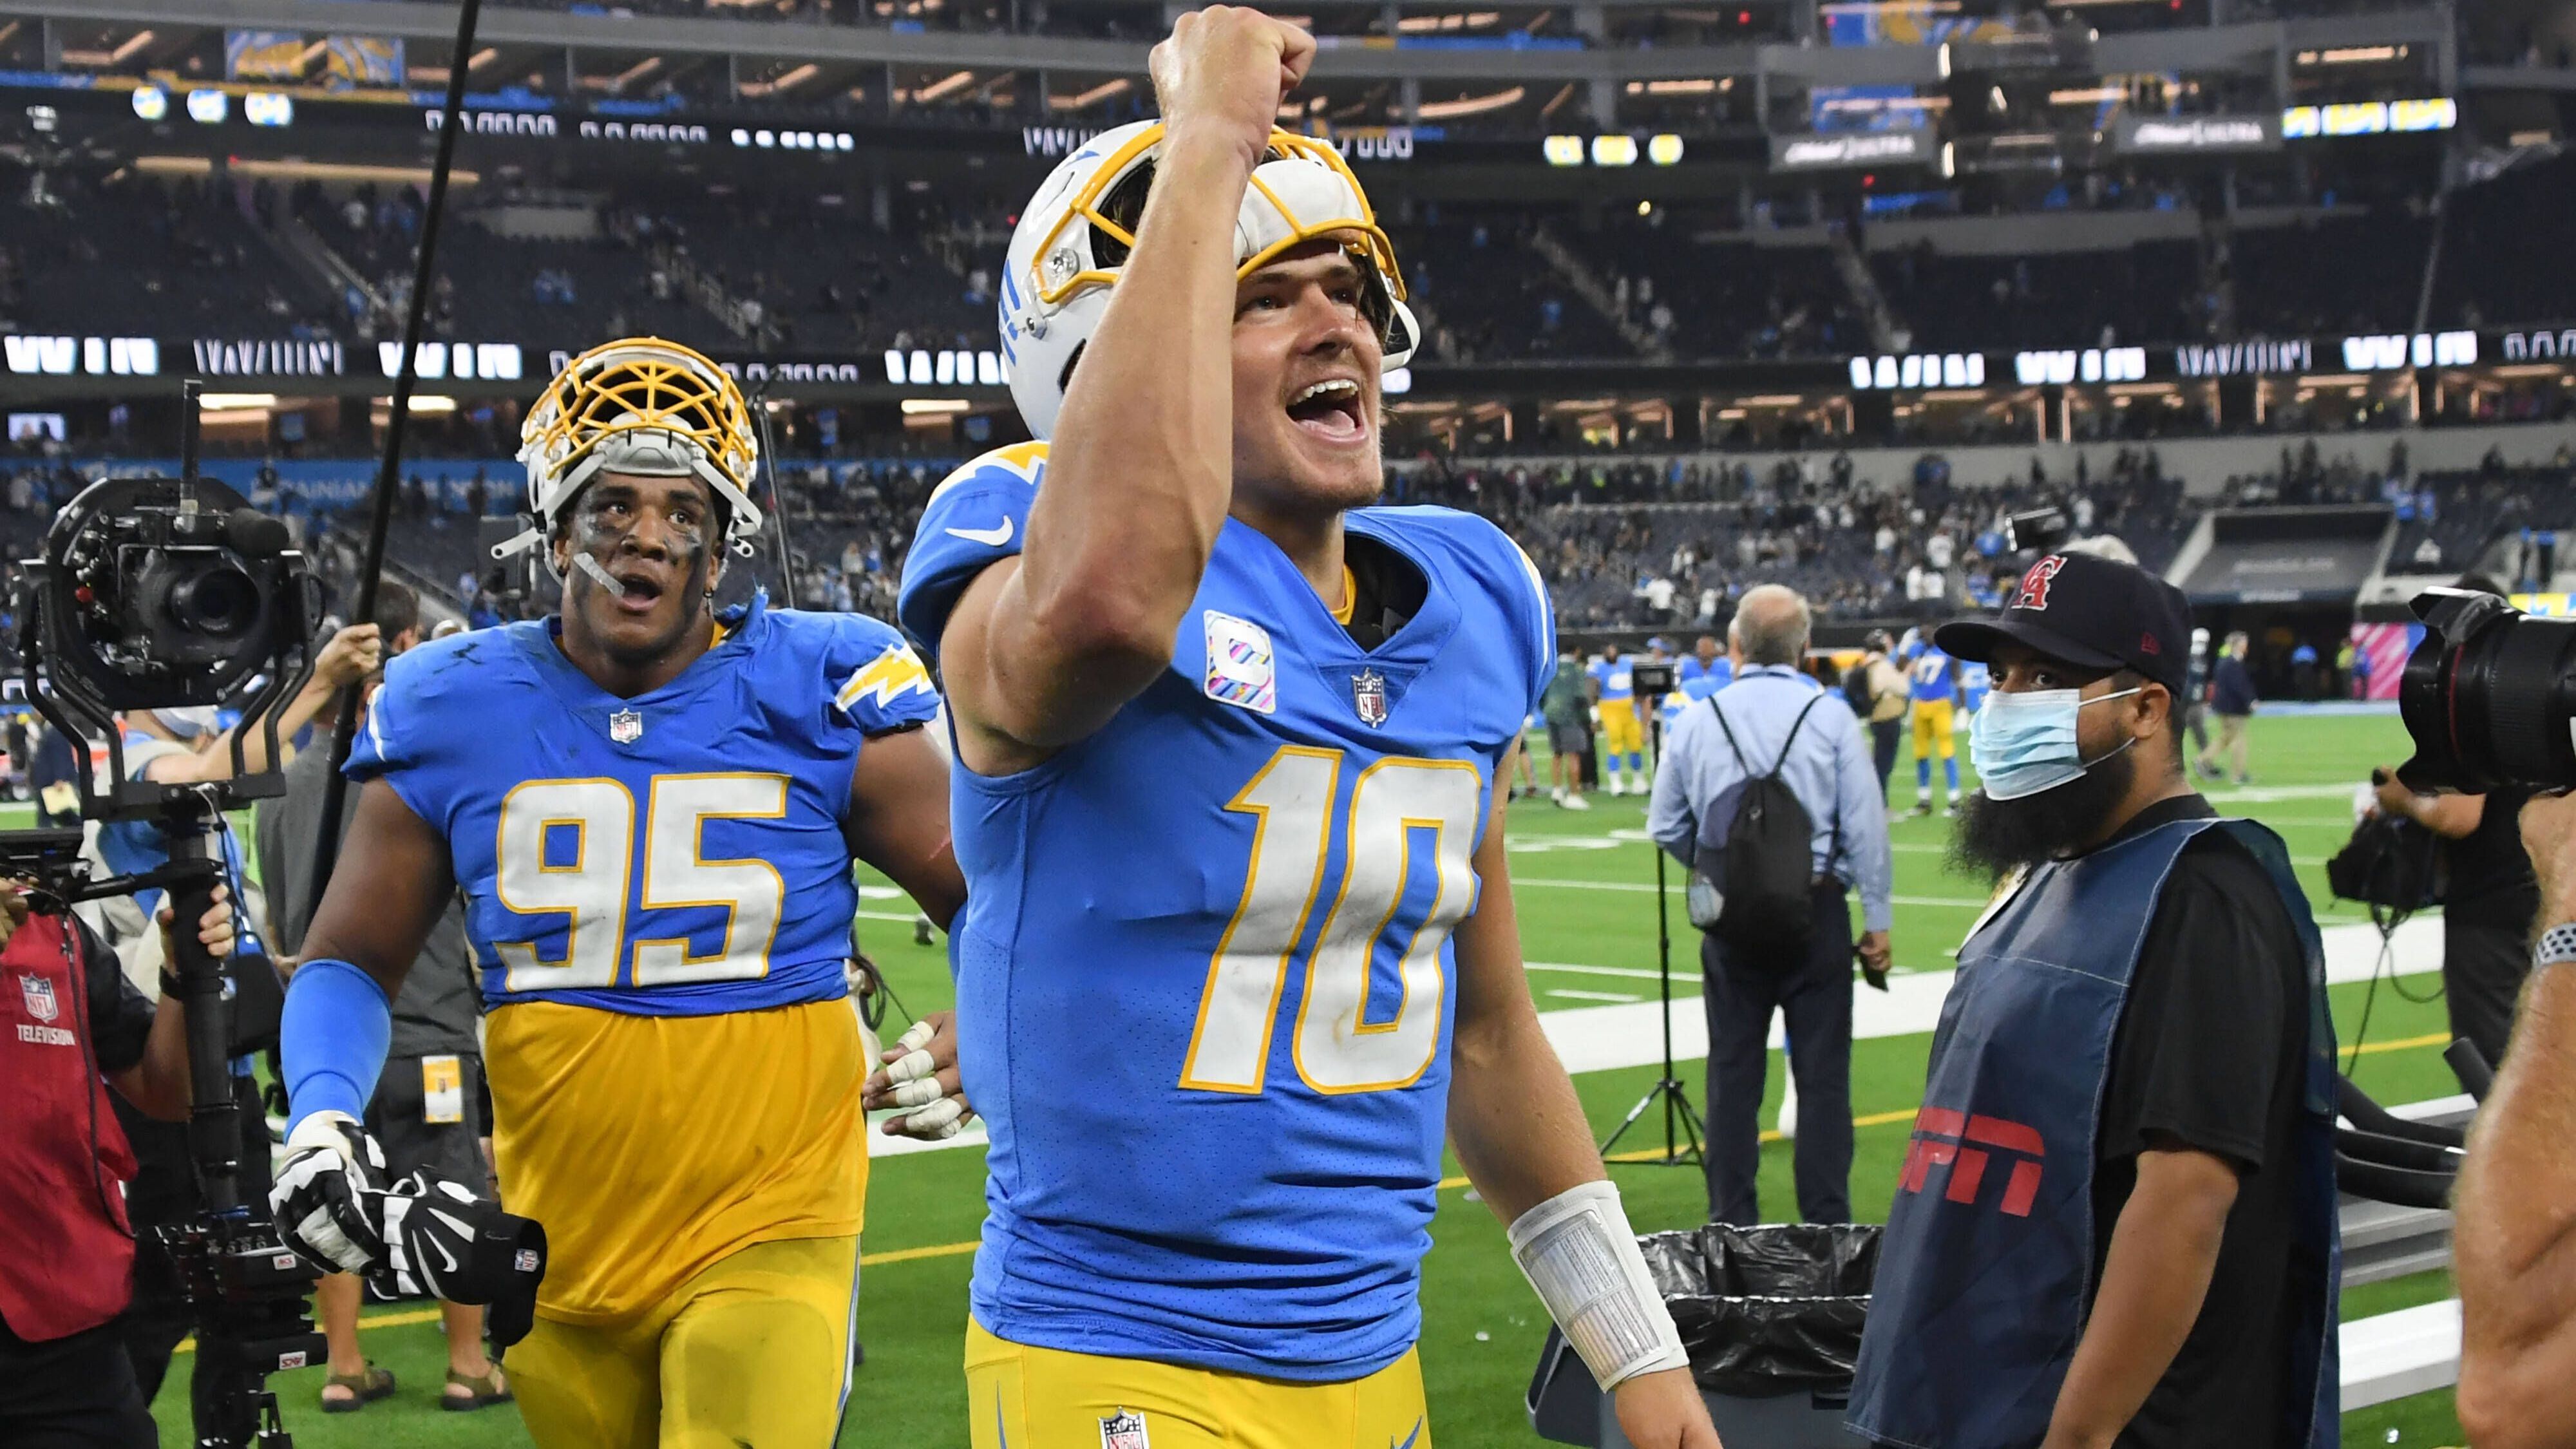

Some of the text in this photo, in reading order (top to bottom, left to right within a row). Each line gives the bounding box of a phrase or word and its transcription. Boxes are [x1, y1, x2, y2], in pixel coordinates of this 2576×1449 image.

[4, 335, 158, 375] WIN
[378, 341, 522, 379] WIN
[2016, 346, 2146, 384] WIN
[2342, 330, 2477, 372] WIN
[493, 773, 791, 992] 95
[1177, 744, 1482, 1095] 10
[28, 994, 53, 1016] NFL
[16, 1023, 76, 1046] TELEVISION
